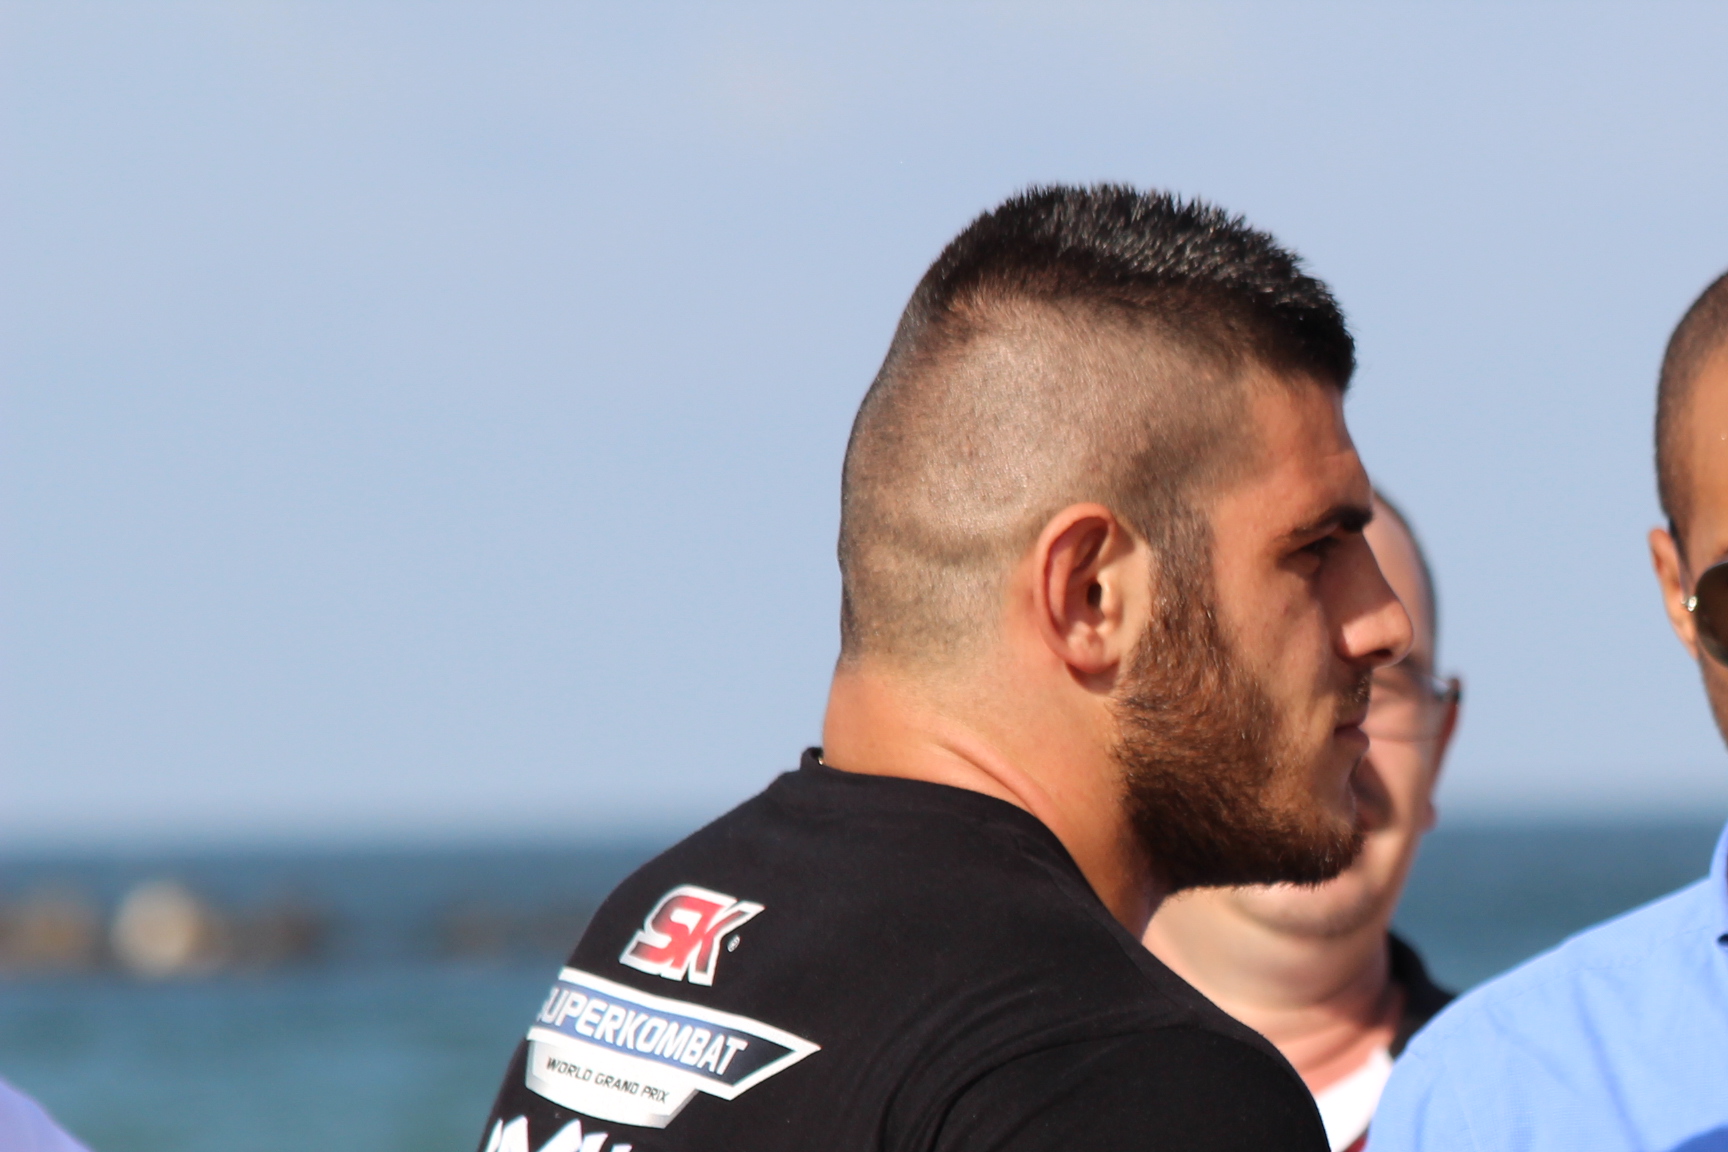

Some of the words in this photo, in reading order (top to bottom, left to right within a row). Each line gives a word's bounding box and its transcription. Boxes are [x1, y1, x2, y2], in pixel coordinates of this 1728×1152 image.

[619, 884, 766, 986] SK
[538, 986, 748, 1076] UPERKOMBAT
[546, 1057, 593, 1082] WORLD
[594, 1073, 640, 1096] GRAND
[640, 1085, 670, 1104] PRIX
